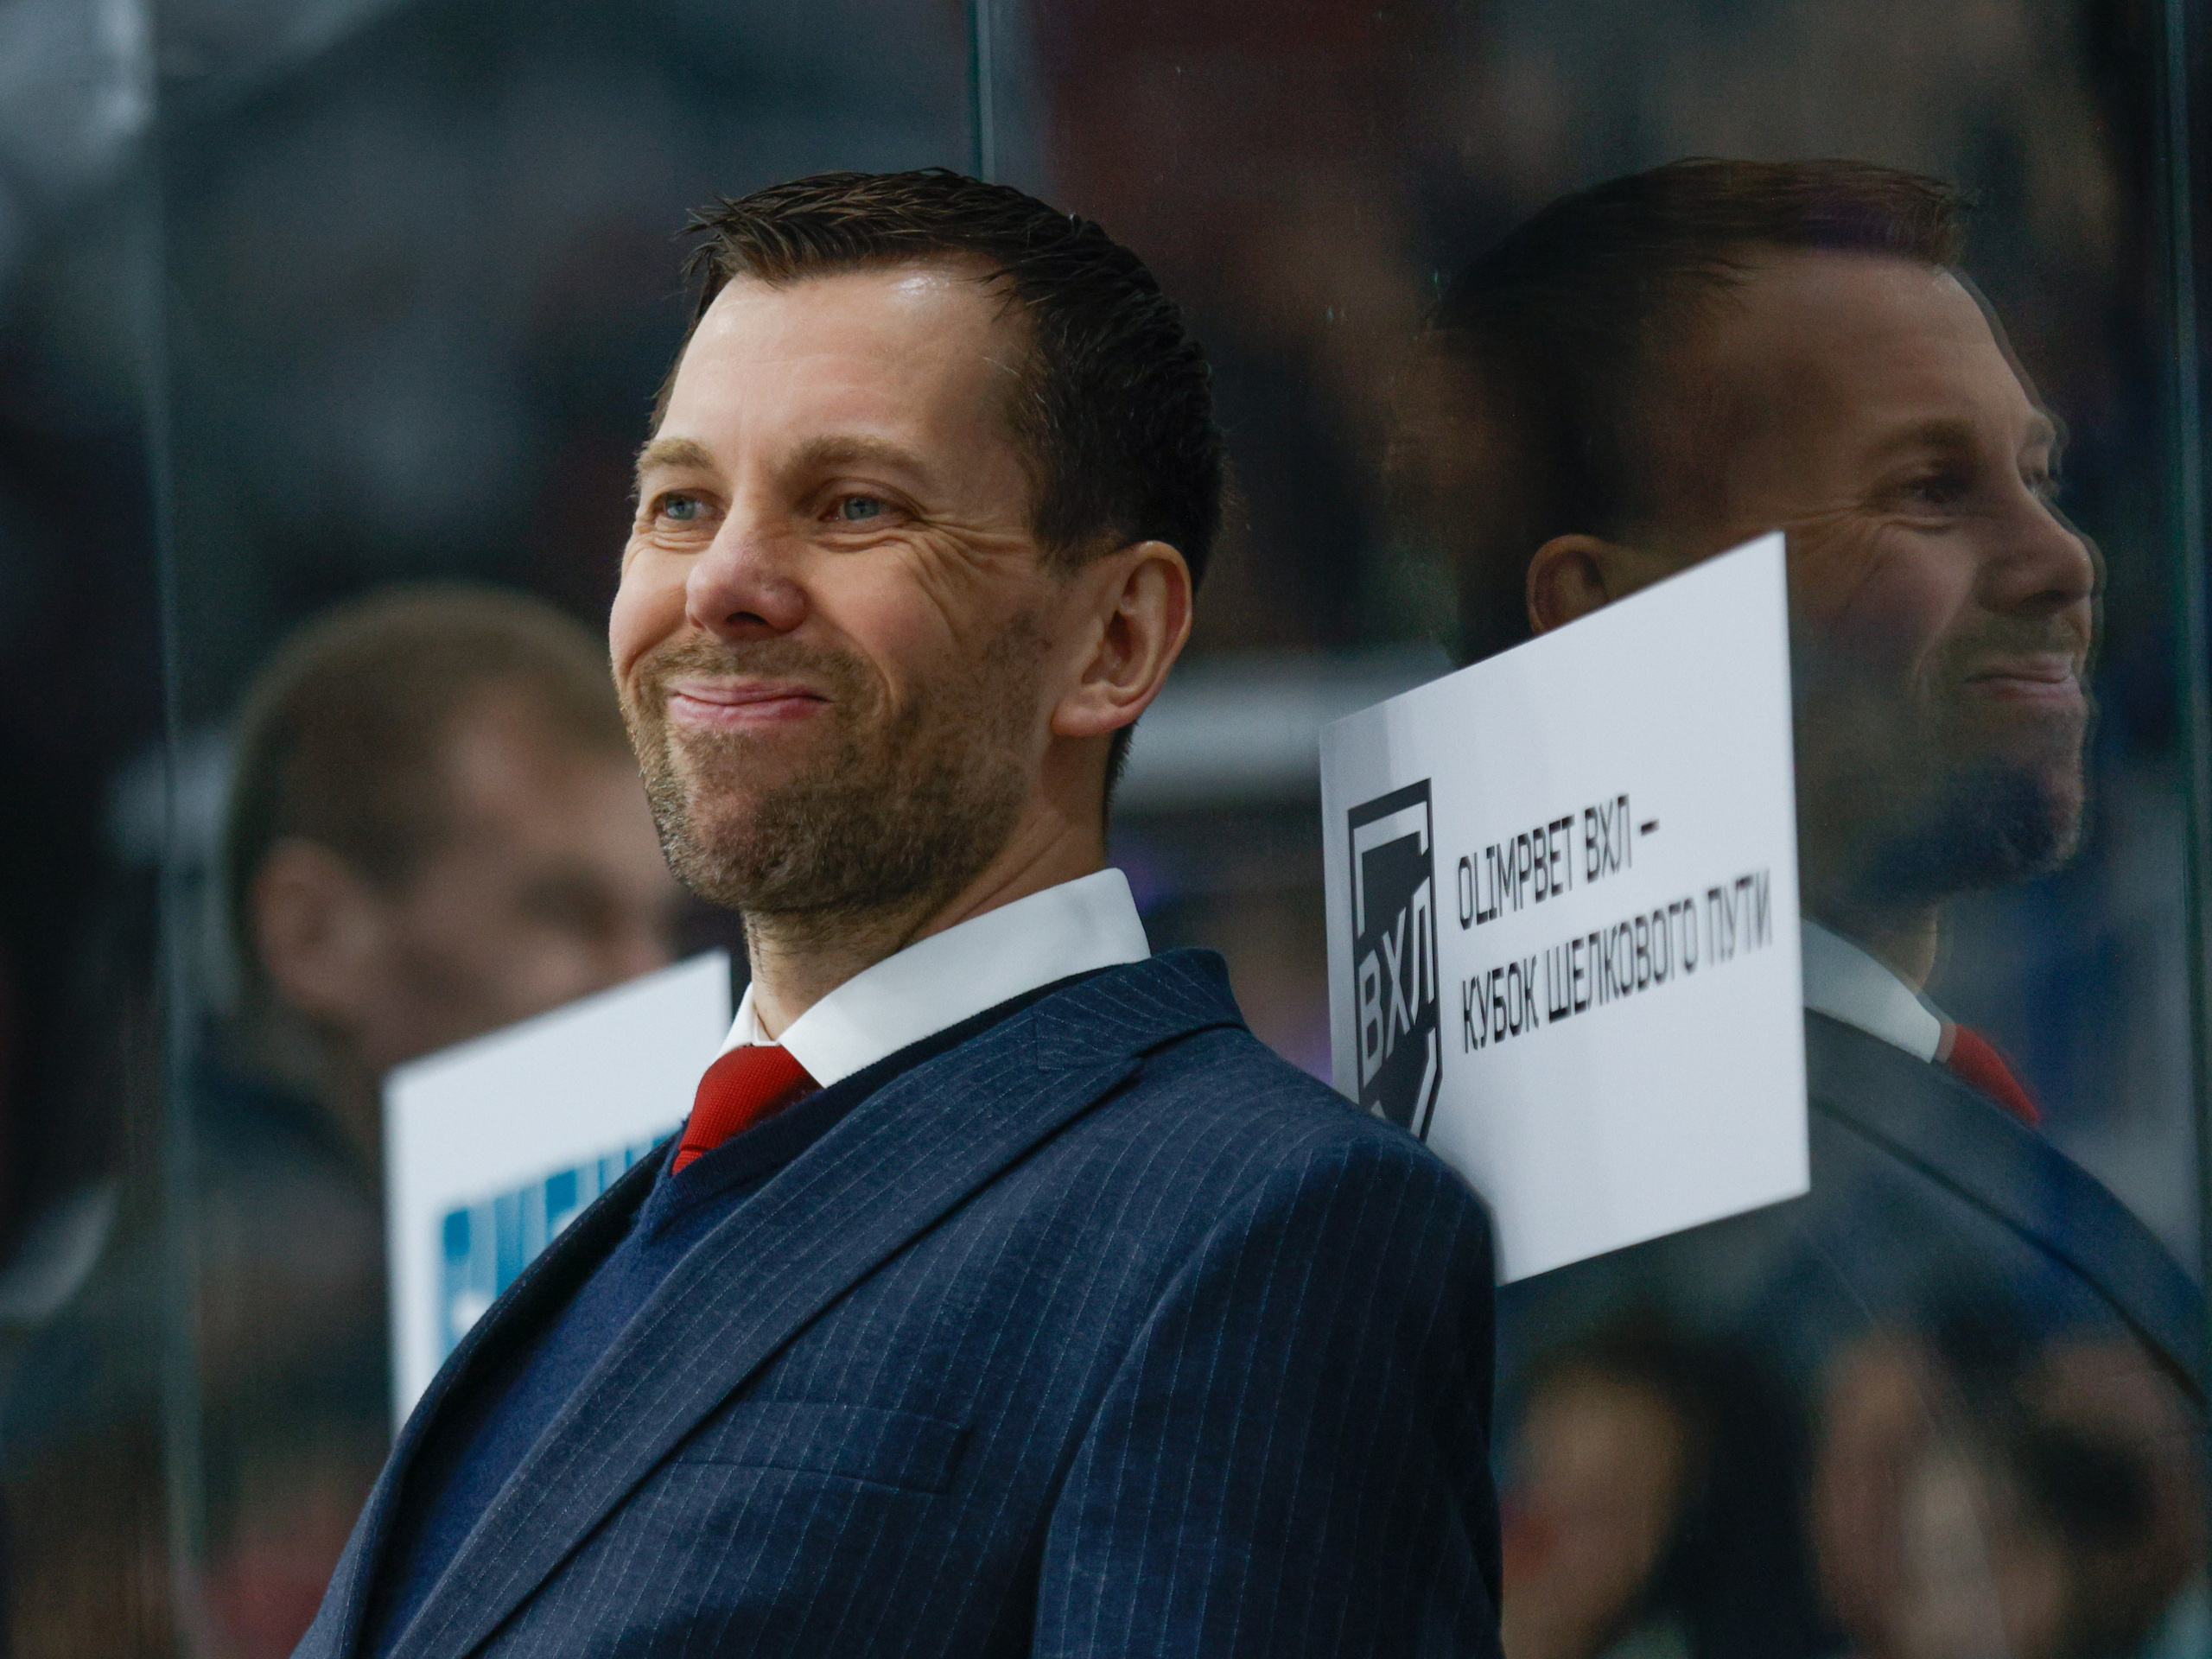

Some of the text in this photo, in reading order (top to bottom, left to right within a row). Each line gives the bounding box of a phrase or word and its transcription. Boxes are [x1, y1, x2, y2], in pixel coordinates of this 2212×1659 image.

[1458, 813, 1575, 931] OLIMPBET
[1585, 793, 1632, 884] ВХЛ
[1358, 876, 1435, 1089] ВХЛ
[1462, 865, 1773, 1055] КУБОК ШЕЛКОВОГО ПУТИ
